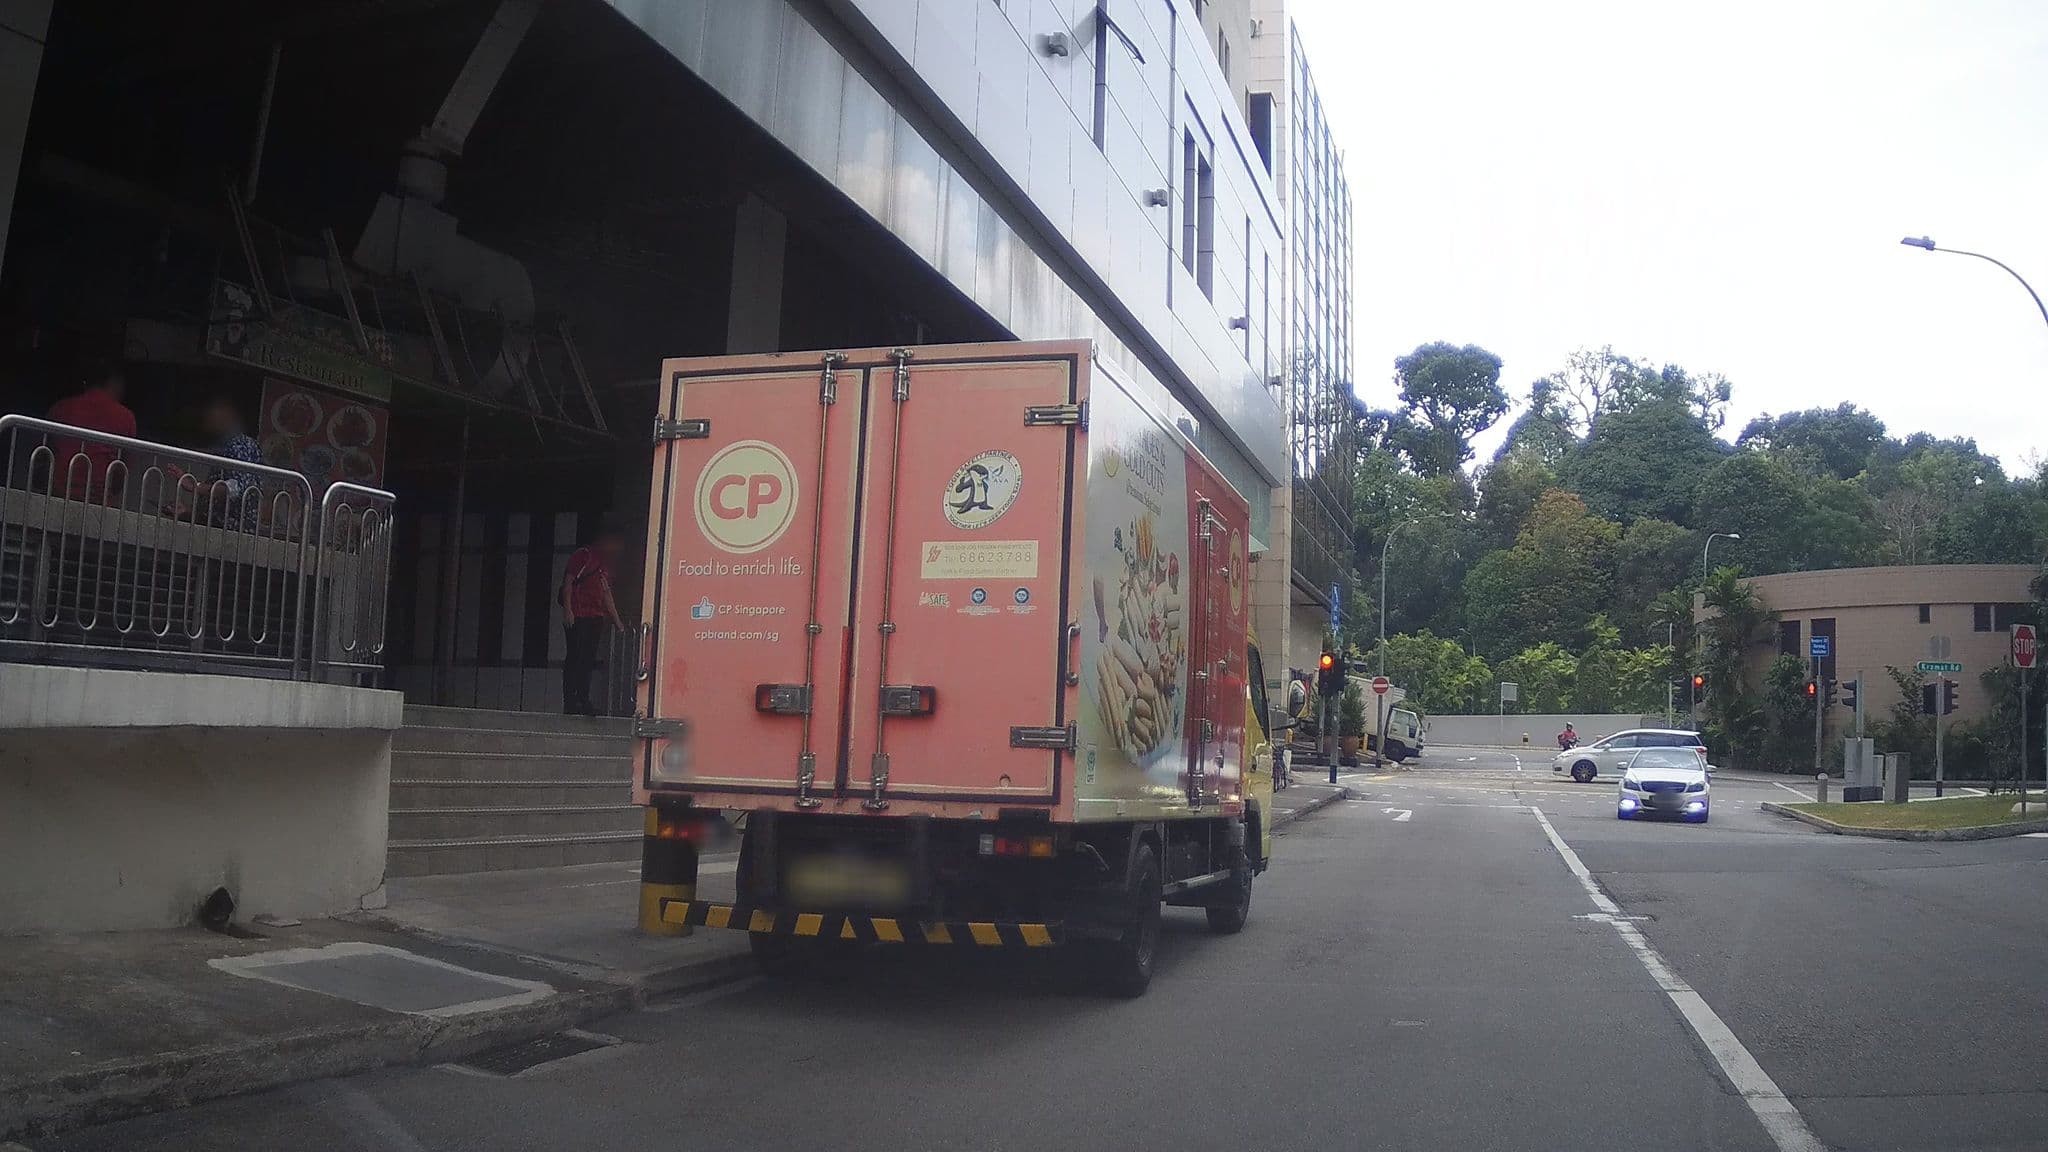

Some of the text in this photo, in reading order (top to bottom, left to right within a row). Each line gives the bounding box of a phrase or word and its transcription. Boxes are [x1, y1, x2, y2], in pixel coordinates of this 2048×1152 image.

[709, 474, 782, 520] CP
[678, 556, 805, 576] Food to enrich life.
[718, 604, 786, 616] CP Singapore
[694, 630, 779, 642] cpbrand.com/sg
[2015, 638, 2034, 654] STOP
